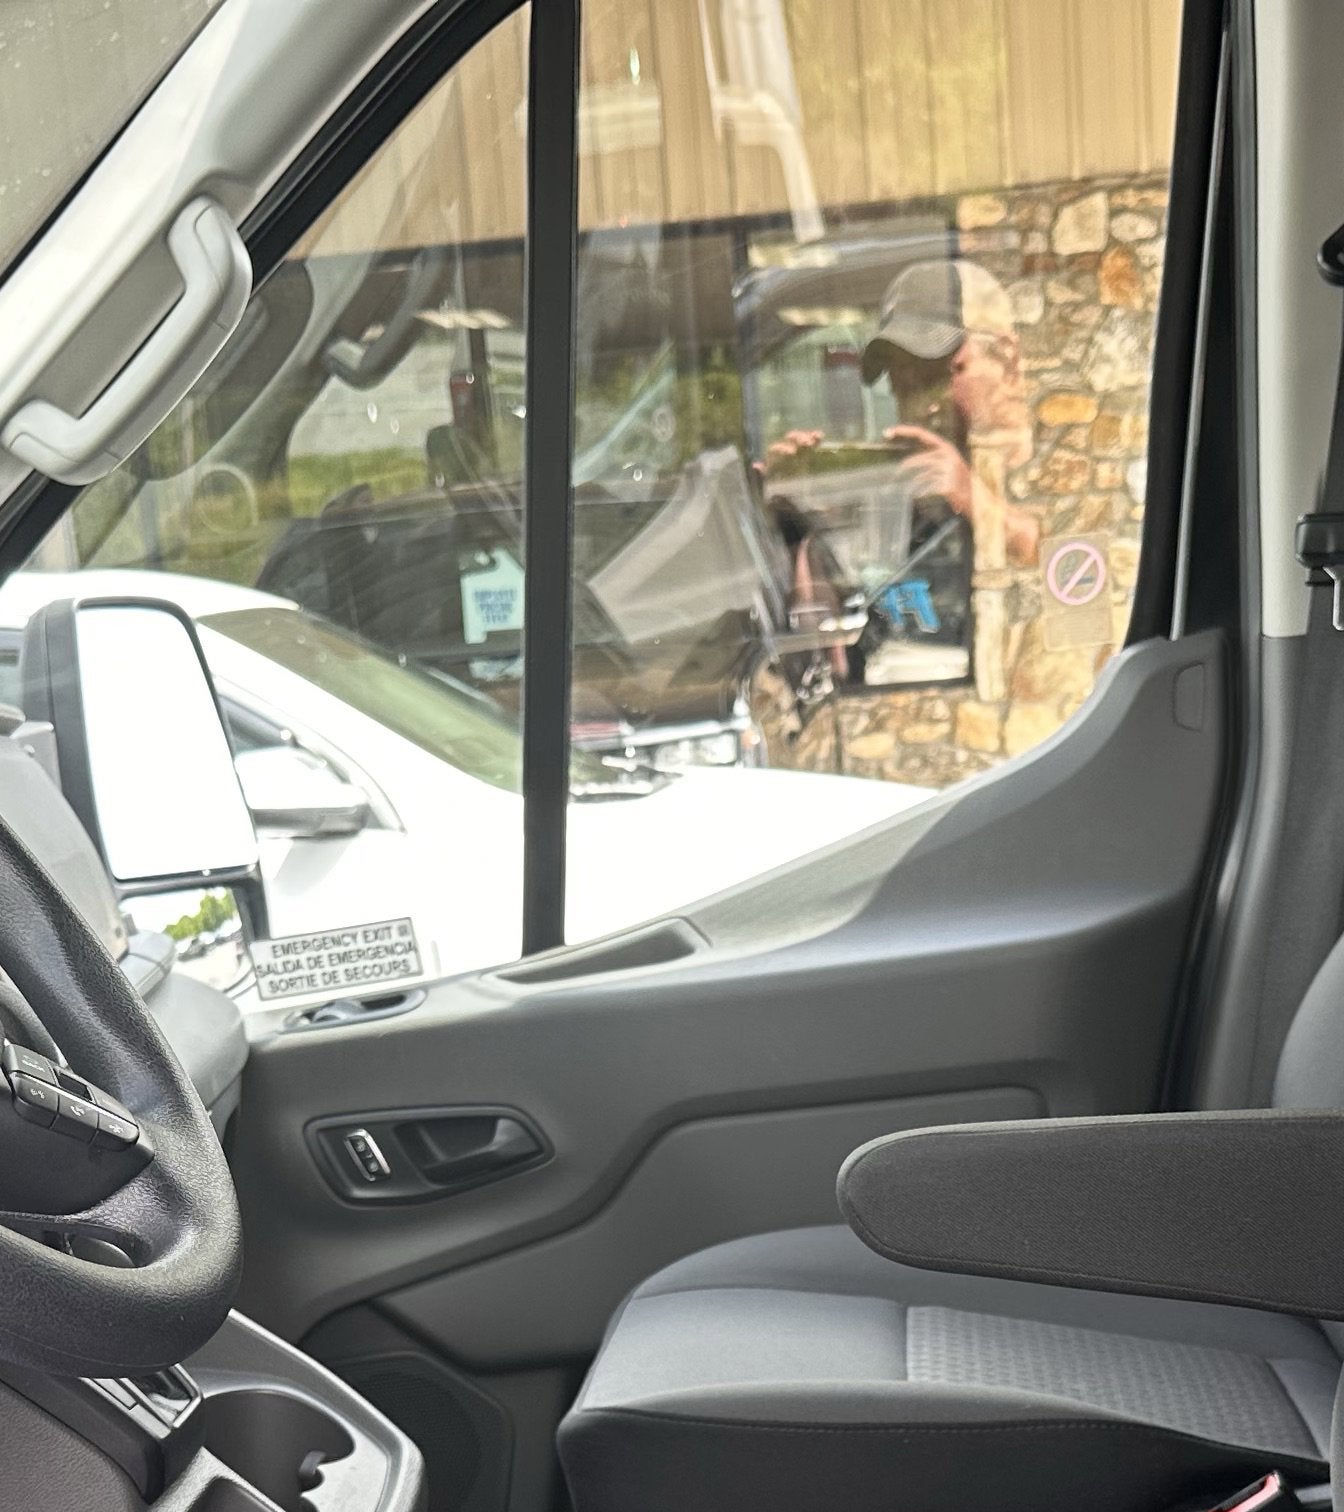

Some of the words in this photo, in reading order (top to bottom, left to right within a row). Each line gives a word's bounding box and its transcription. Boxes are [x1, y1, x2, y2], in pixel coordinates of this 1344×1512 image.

[271, 931, 358, 958] EMERGENCY
[363, 926, 392, 943] EXIT
[256, 959, 303, 978] SALIDA
[307, 955, 325, 970] DE
[328, 942, 417, 966] EMERGENCIA
[268, 975, 319, 993] SORTIE
[322, 970, 341, 985] DE
[344, 959, 411, 981] SECOURS
